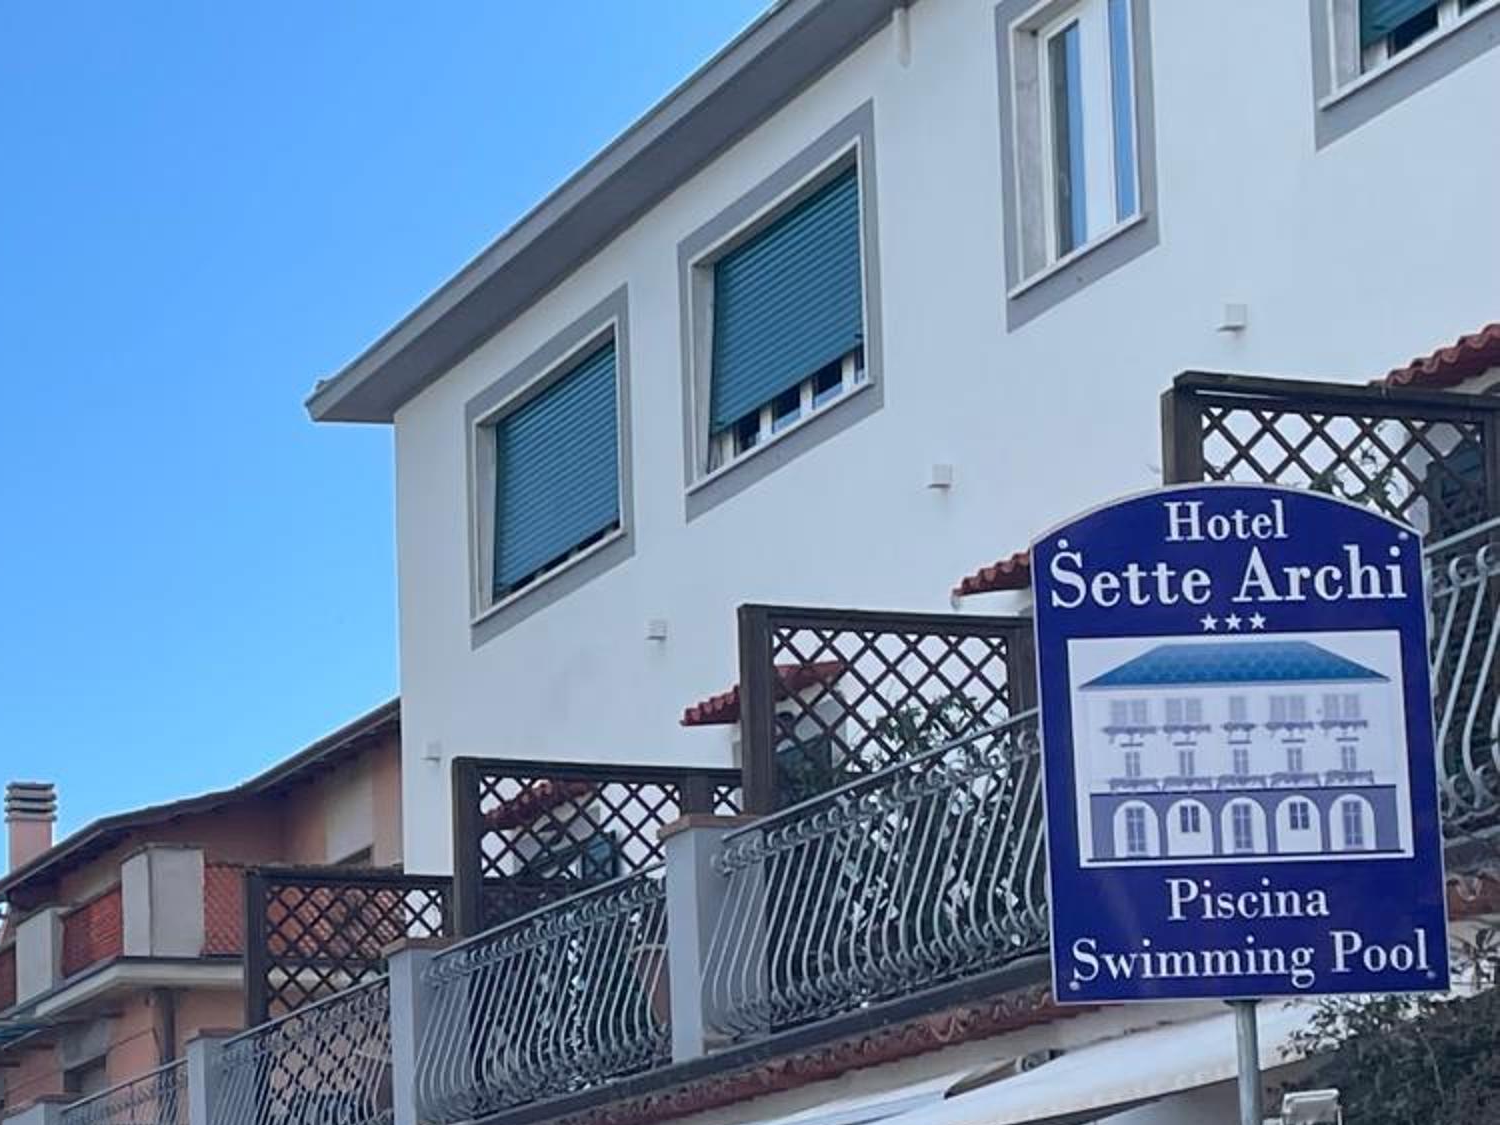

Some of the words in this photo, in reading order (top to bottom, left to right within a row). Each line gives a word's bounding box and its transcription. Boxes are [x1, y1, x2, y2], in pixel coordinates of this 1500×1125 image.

[1164, 498, 1288, 543] Hotel
[1050, 549, 1211, 608] Sette
[1231, 543, 1407, 604] Archi
[1165, 877, 1330, 921] Piscina
[1072, 936, 1315, 989] Swimming
[1329, 928, 1430, 974] Pool
